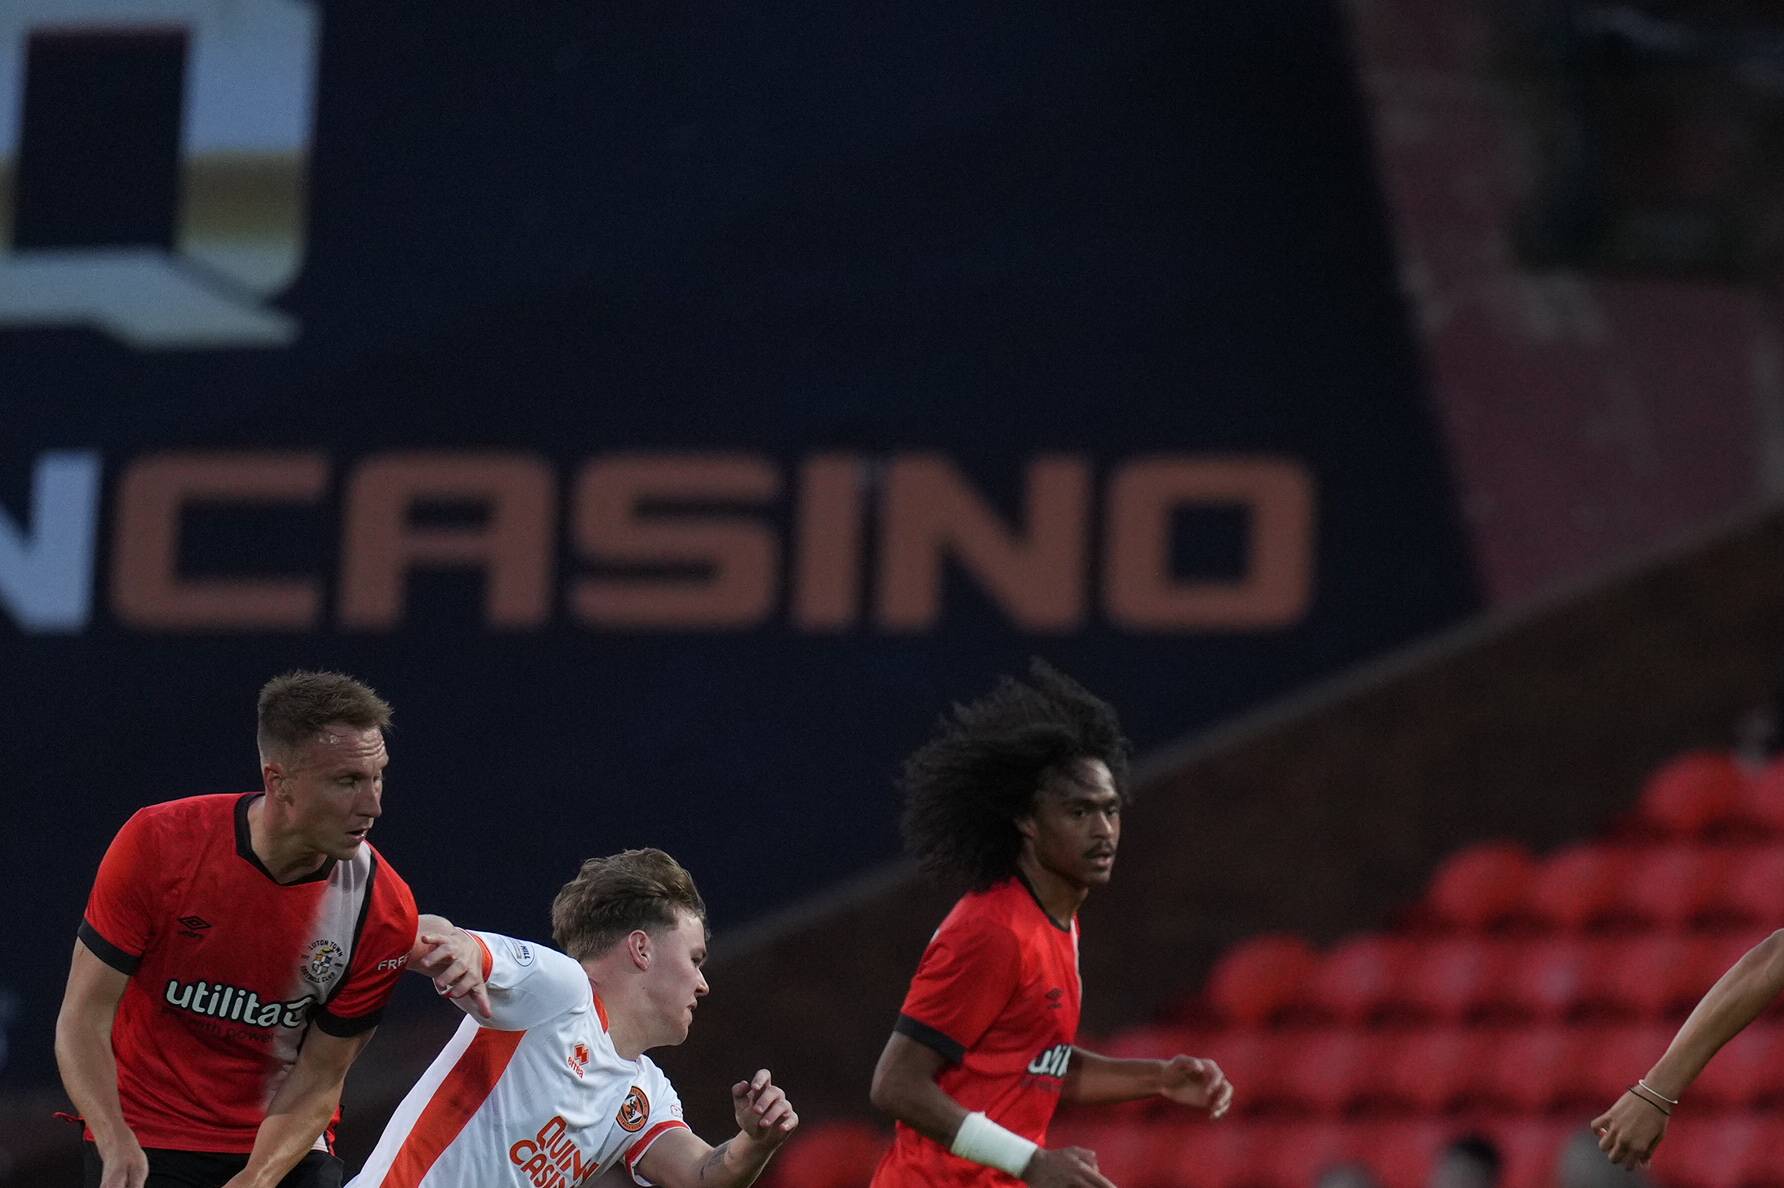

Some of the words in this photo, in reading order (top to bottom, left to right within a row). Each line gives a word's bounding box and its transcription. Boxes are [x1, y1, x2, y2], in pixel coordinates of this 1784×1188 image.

[308, 939, 329, 951] LUTON
[329, 941, 344, 958] TOWN
[165, 979, 282, 1028] utilita
